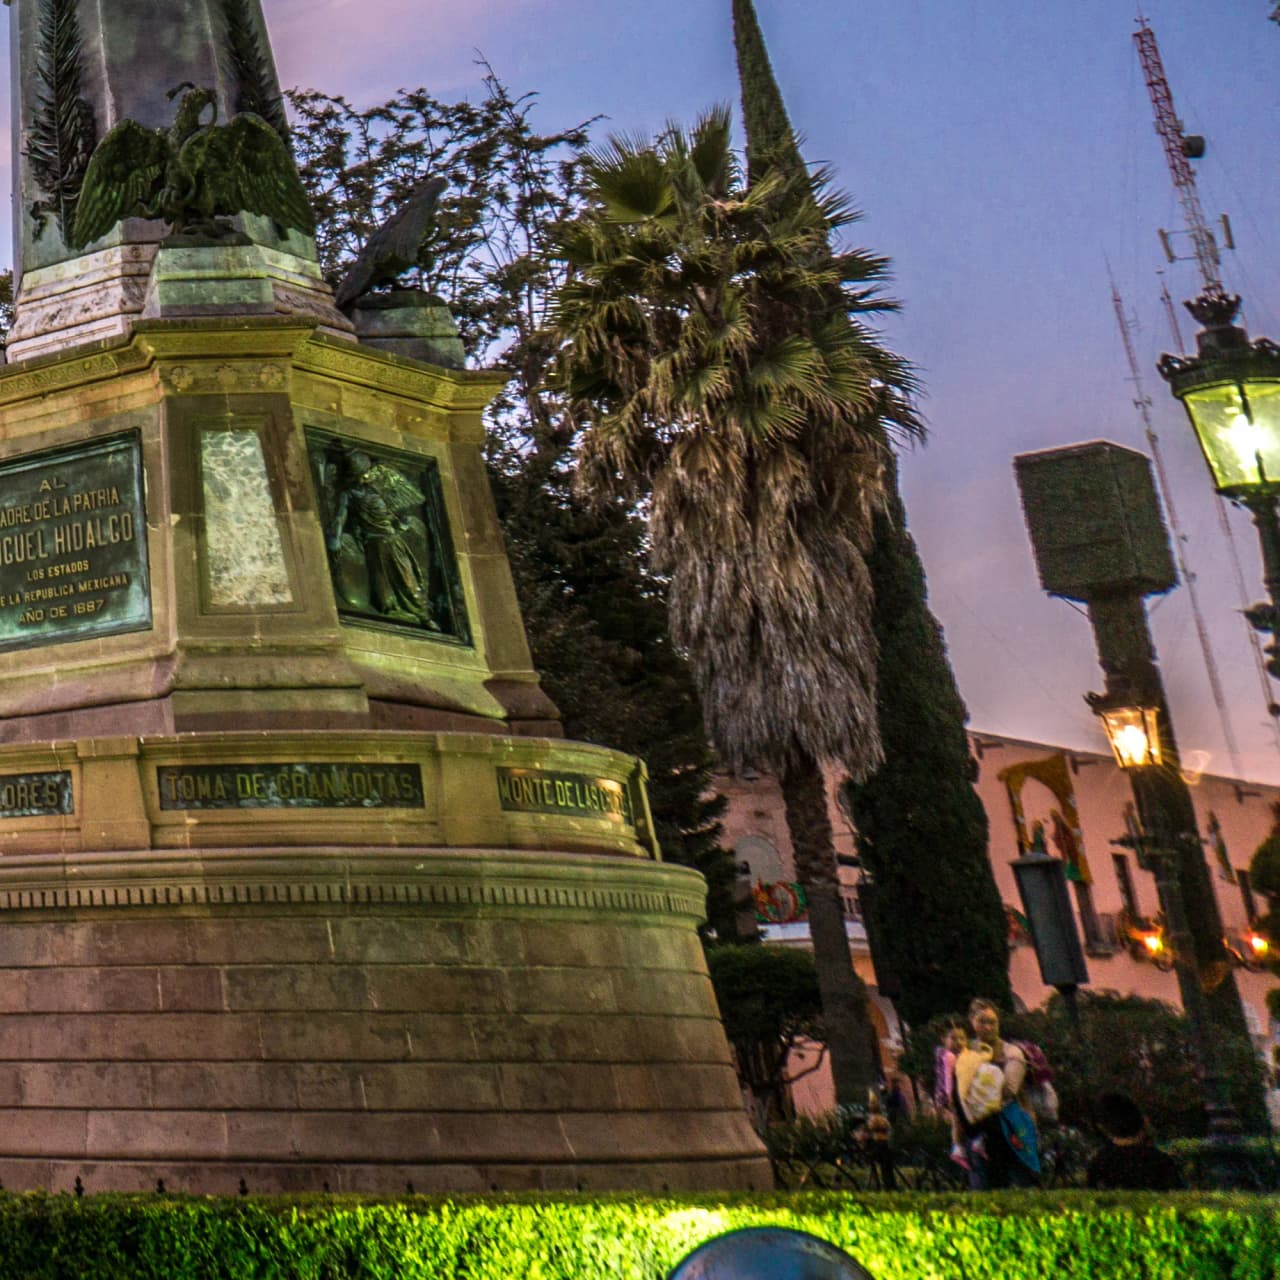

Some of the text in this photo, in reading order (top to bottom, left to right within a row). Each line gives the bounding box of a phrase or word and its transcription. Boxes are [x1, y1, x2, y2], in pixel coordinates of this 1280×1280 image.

[39, 476, 67, 493] AL
[34, 500, 51, 521] DE
[52, 498, 71, 517] LA
[73, 485, 120, 513] PATRIA
[54, 512, 134, 555] HIDALGO
[26, 559, 90, 582] LOS ESTADOS
[8, 593, 21, 606] LA
[24, 583, 75, 604] REPUBLICA
[78, 572, 129, 594] MEXICANA
[18, 598, 106, 625] AÑO DE 1887
[167, 772, 416, 801] TOMA DE GRANADITAS
[498, 775, 555, 807] MONTE
[554, 779, 576, 808] DE
[575, 782, 600, 811] LAS
